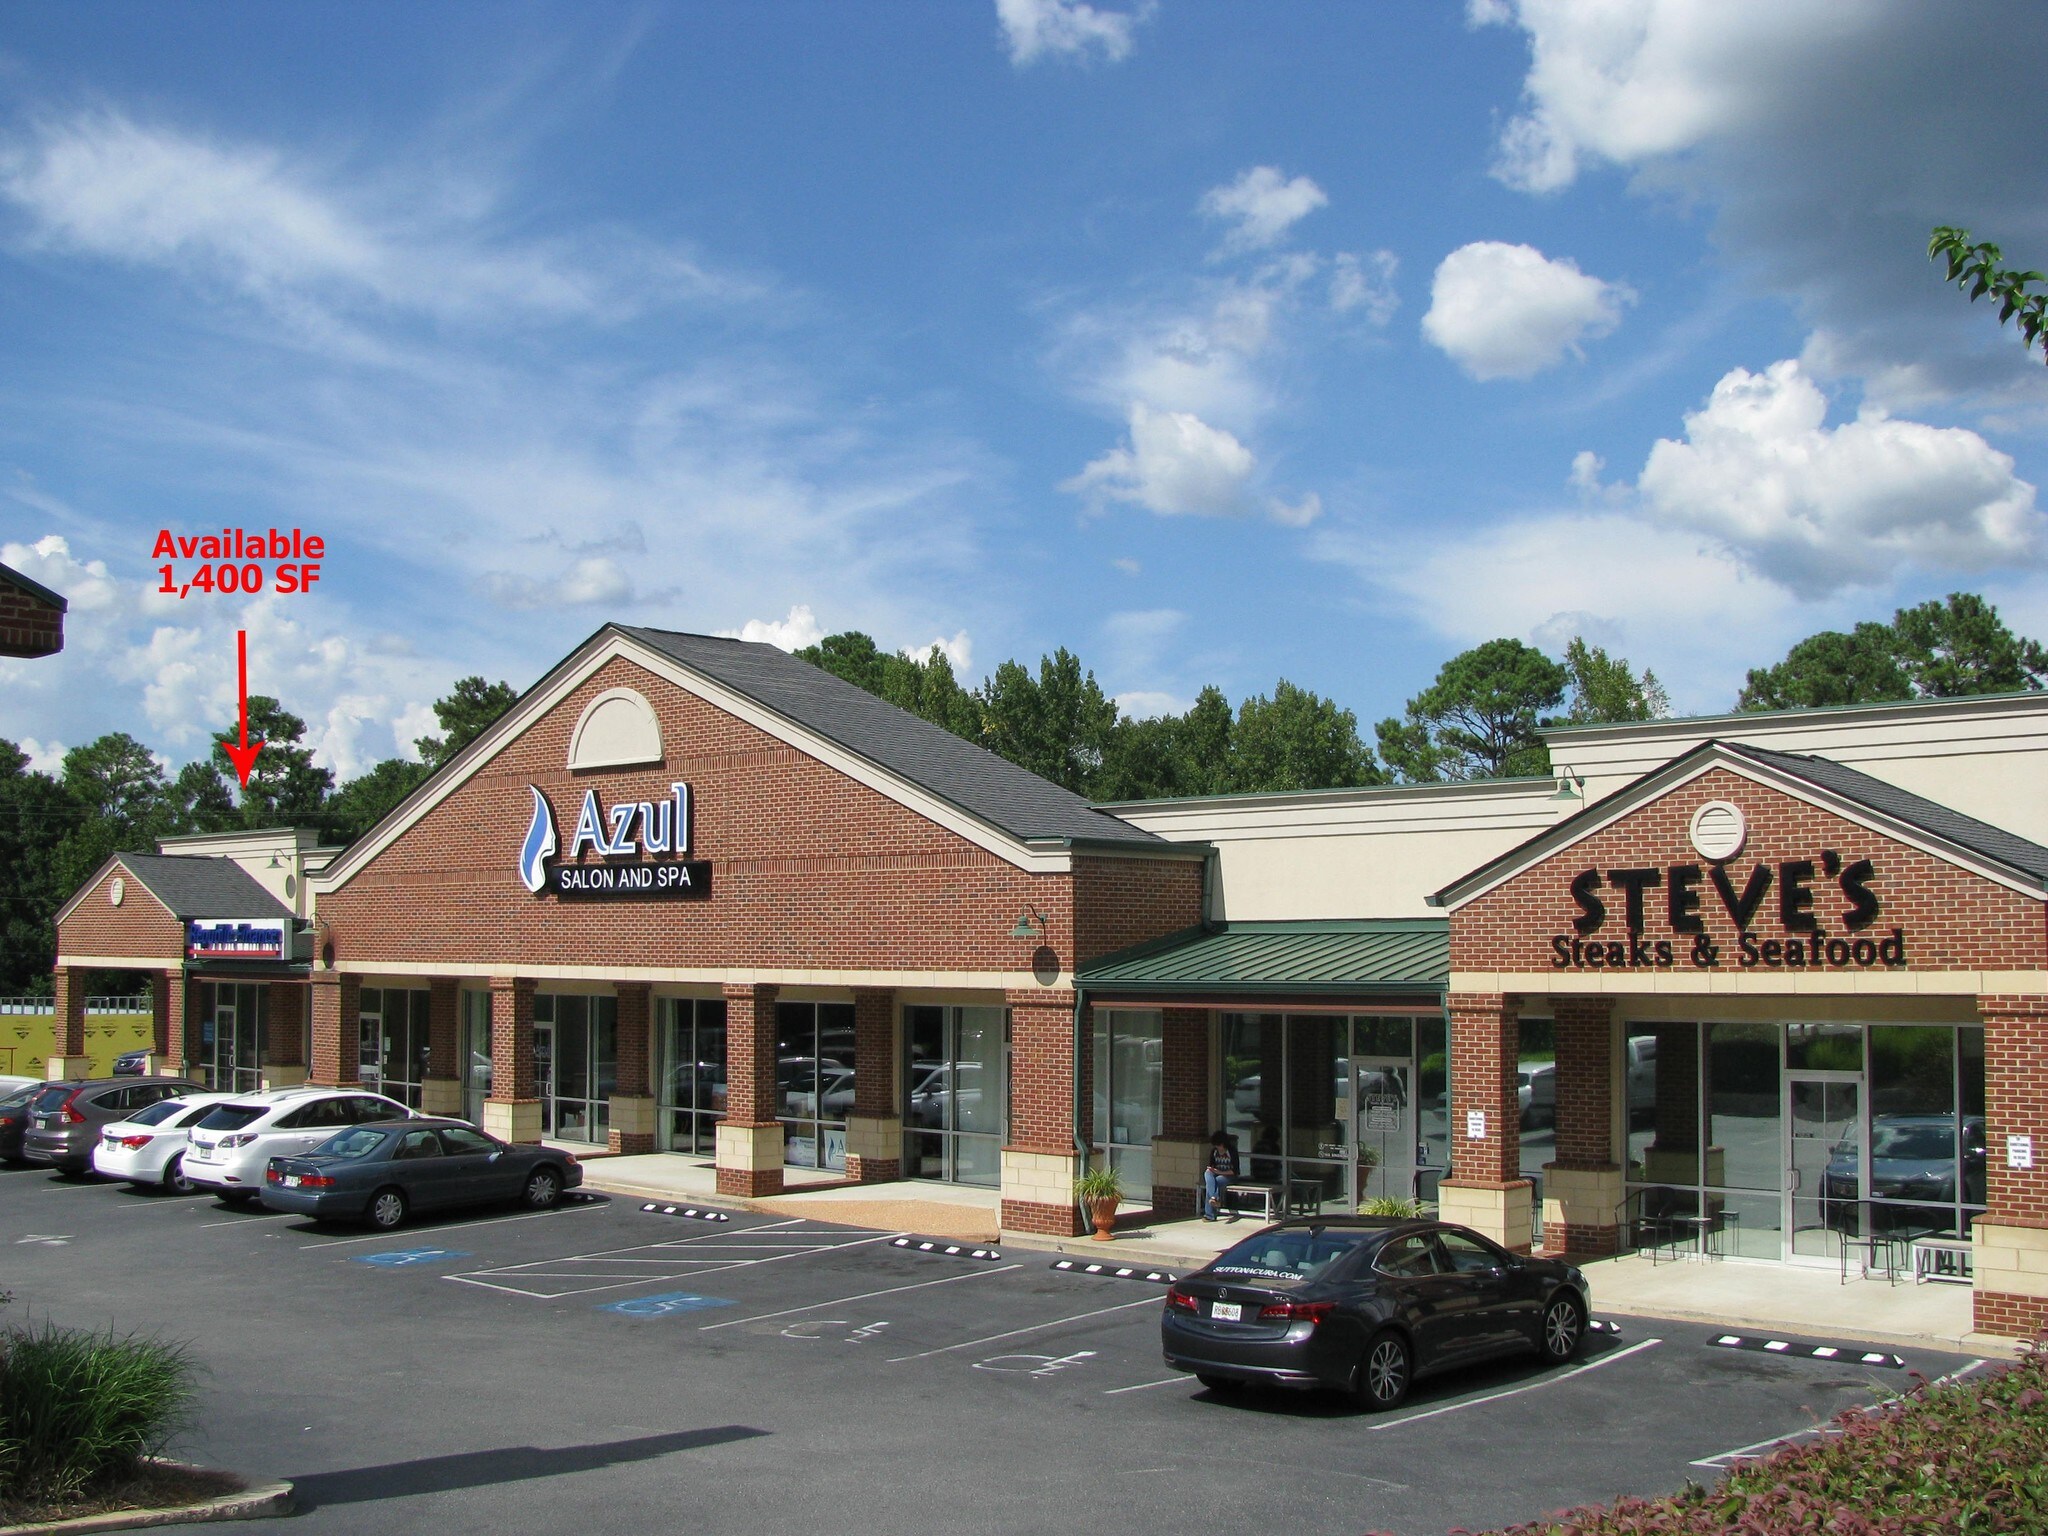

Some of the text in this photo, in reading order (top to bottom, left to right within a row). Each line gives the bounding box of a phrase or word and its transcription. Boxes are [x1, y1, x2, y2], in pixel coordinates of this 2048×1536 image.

[570, 782, 688, 857] Azul
[561, 866, 691, 889] SALON AND SPA
[1570, 850, 1879, 936] STEVE'S
[1551, 928, 1907, 968] Steaks & Seafood
[1213, 1266, 1304, 1281] SUTTONACURA.COM
